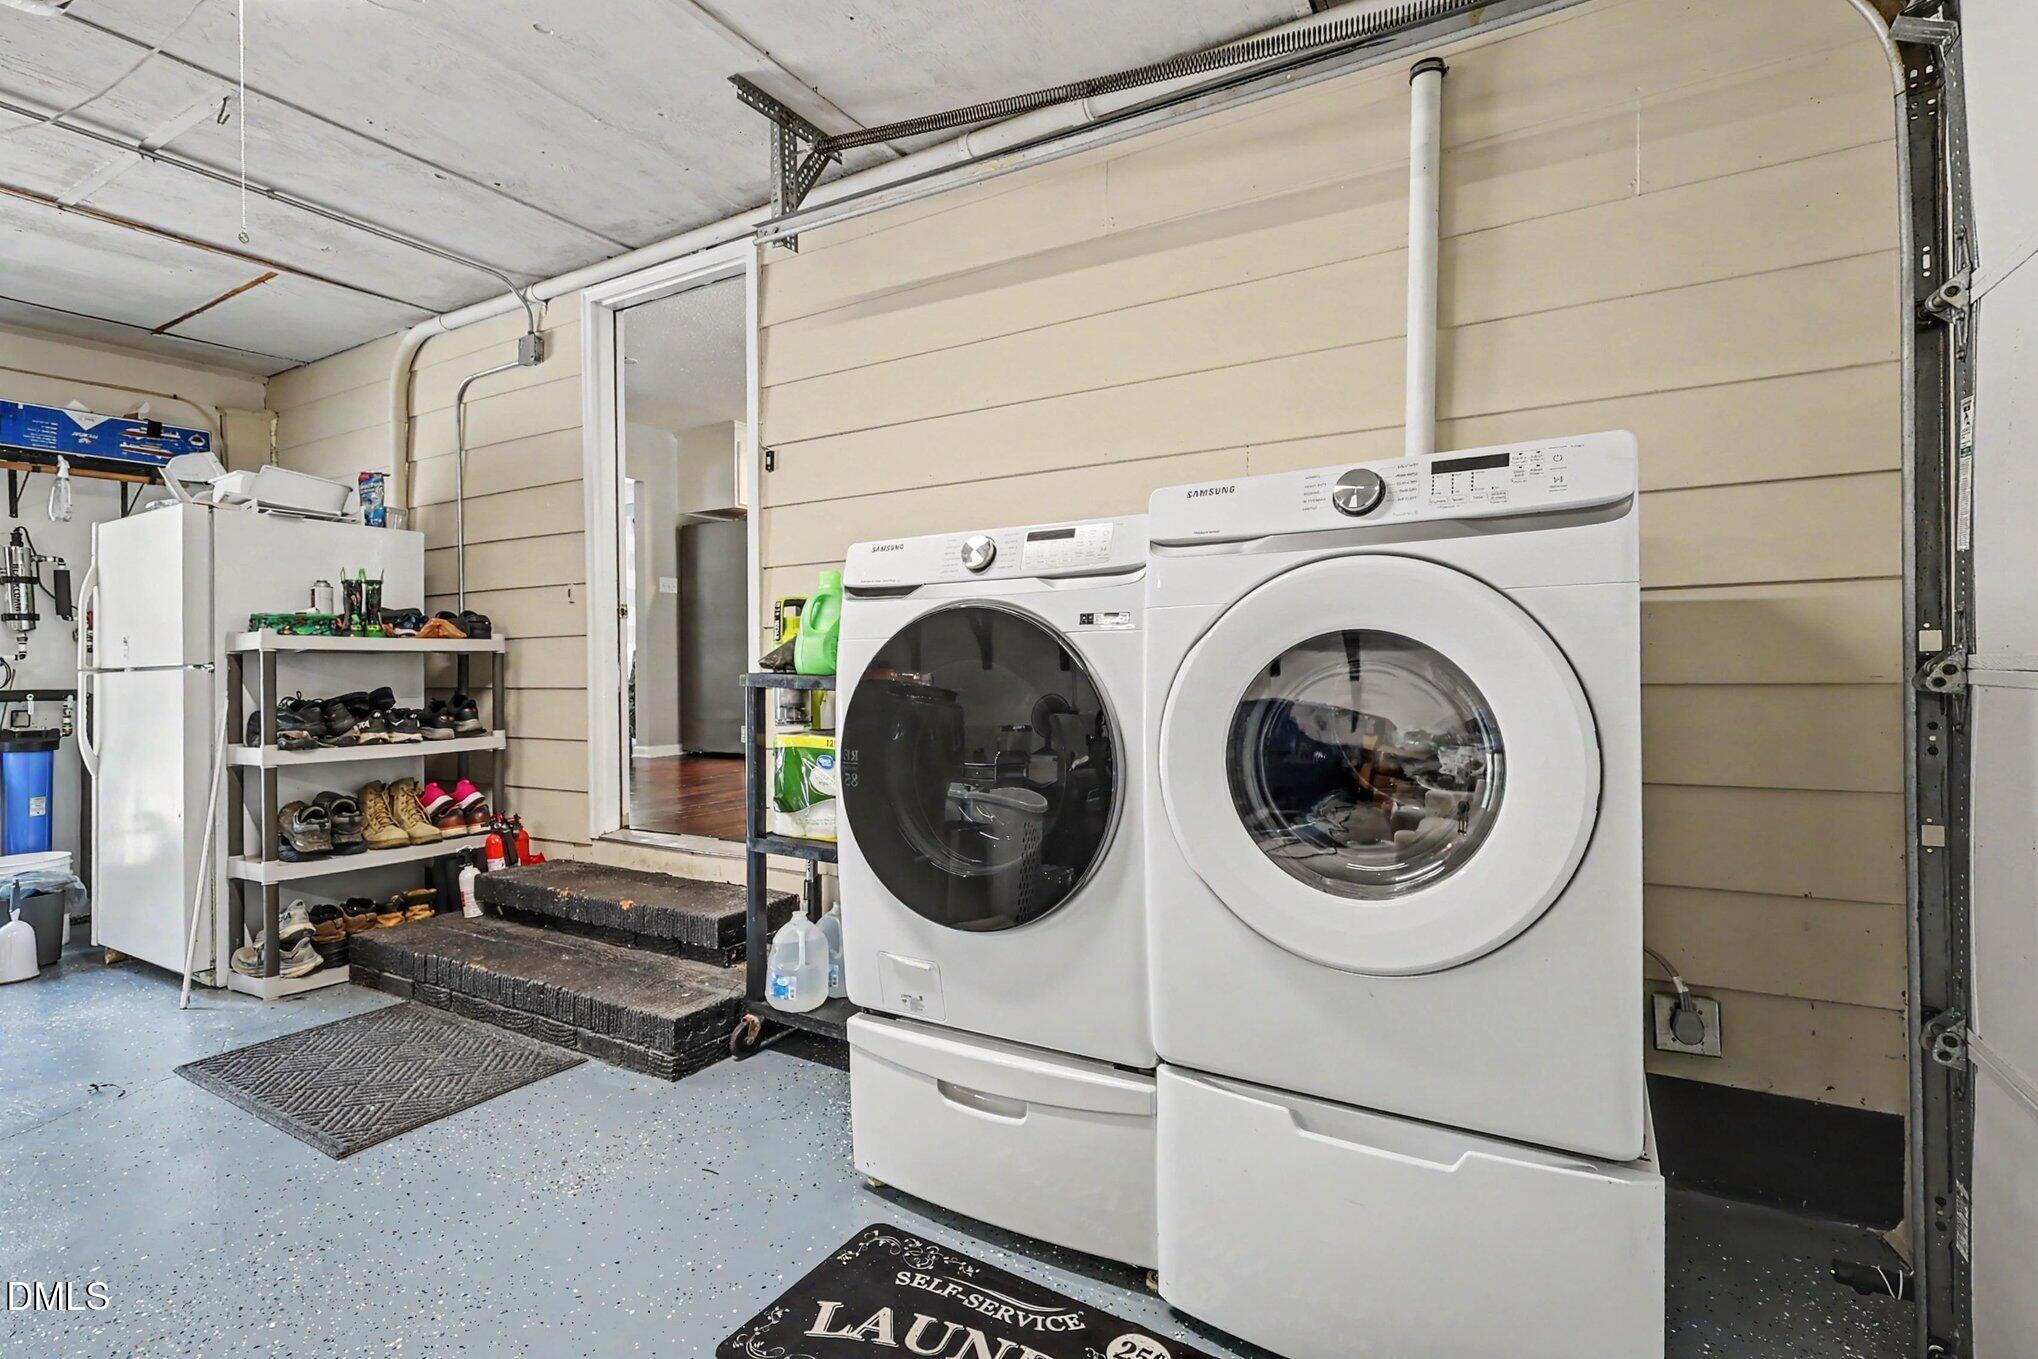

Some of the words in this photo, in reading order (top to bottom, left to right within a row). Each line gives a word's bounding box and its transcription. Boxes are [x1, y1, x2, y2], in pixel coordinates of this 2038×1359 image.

[1186, 485, 1236, 499] SAMSUNG
[871, 543, 905, 554] SAMSUNG
[895, 1271, 1086, 1332] SELF-SERVICE
[804, 1300, 1054, 1359] LAUN
